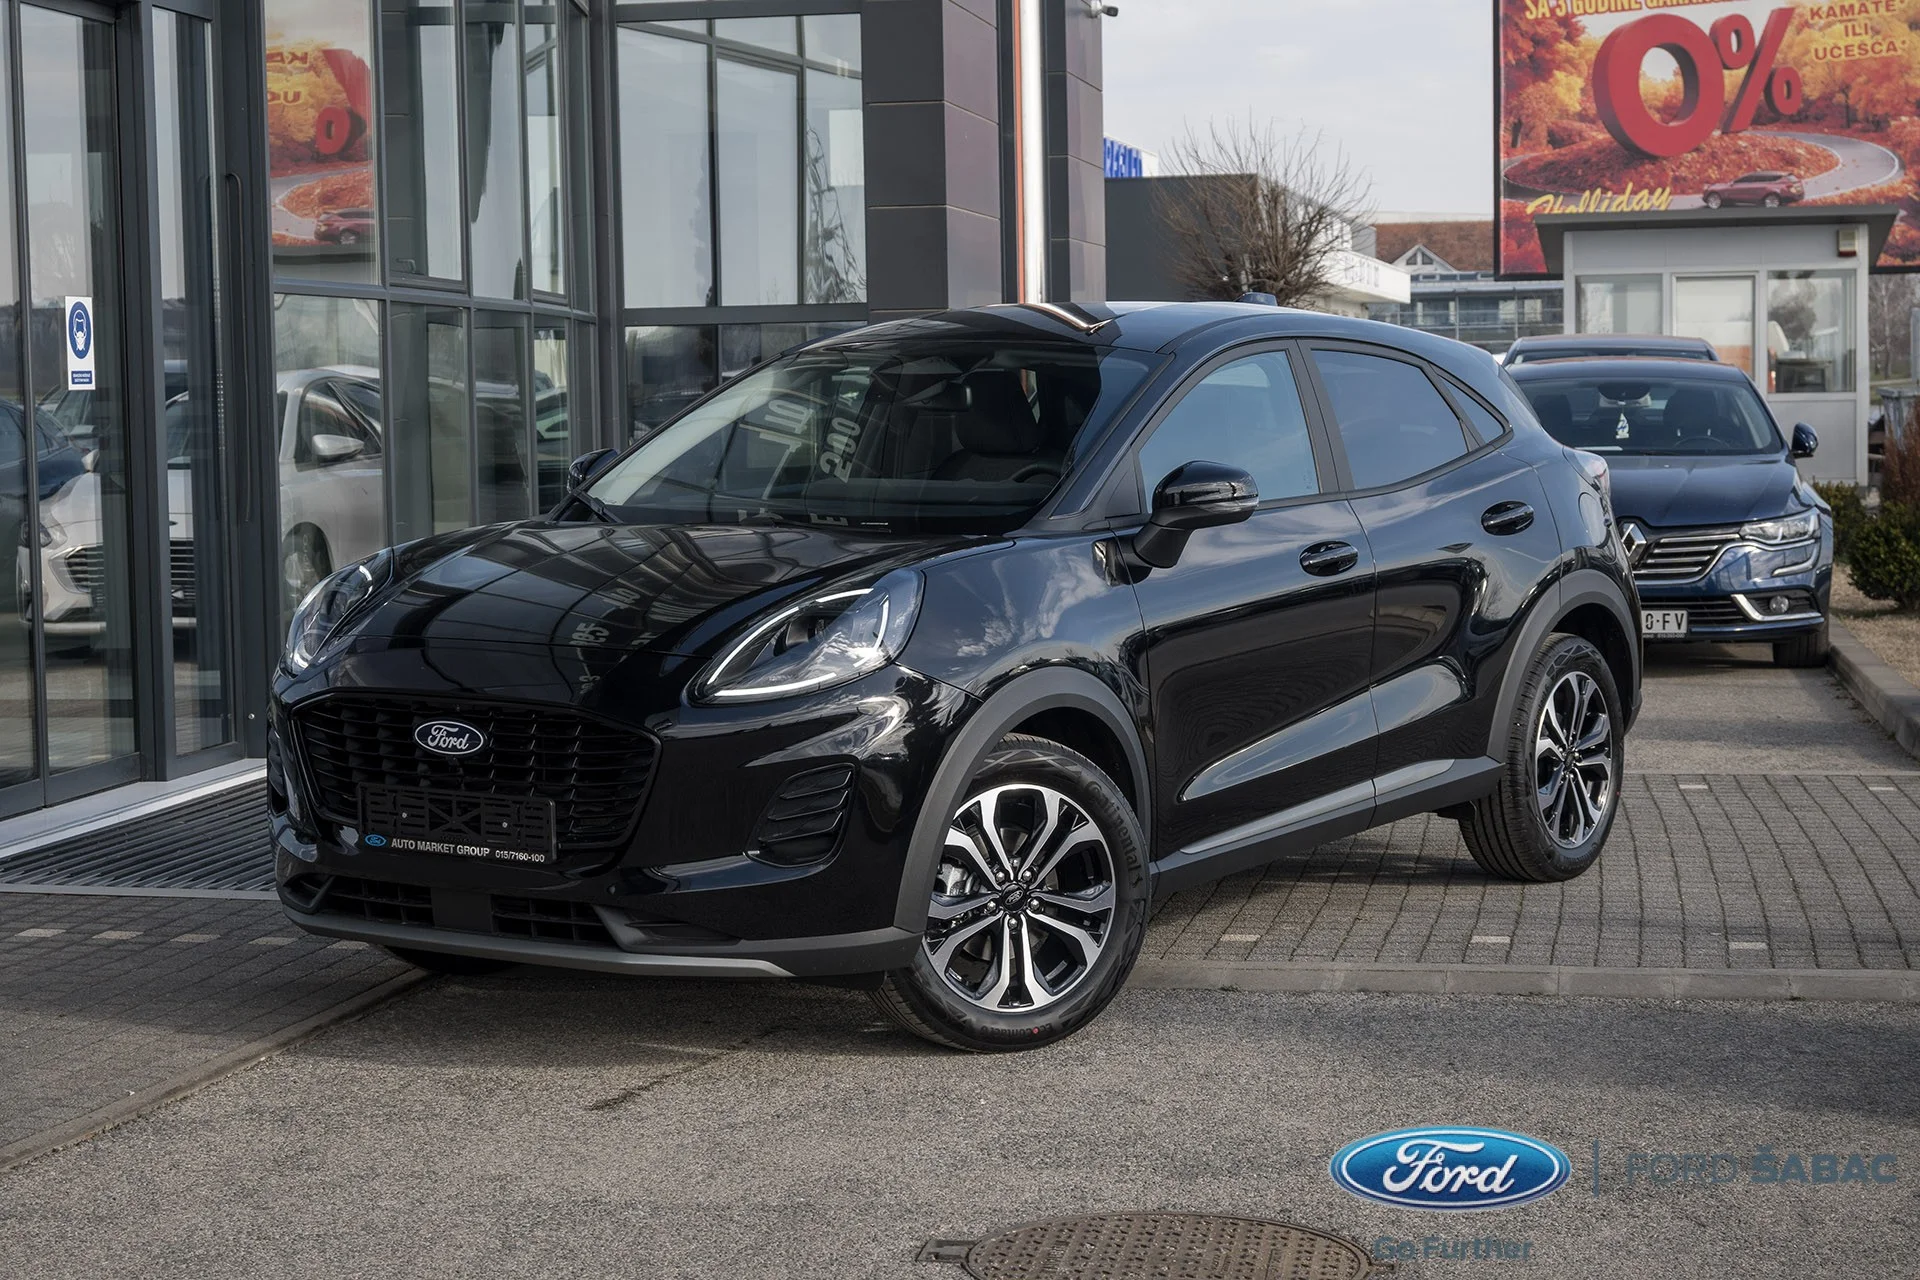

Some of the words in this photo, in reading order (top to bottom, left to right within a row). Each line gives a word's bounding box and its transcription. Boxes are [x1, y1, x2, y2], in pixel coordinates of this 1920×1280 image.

[1809, 0, 1897, 20] KAMATE
[1843, 23, 1869, 37] ILI
[1592, 7, 1801, 159] 0%
[427, 724, 470, 750] Ford
[391, 838, 416, 850] AUTO
[417, 840, 455, 854] MARKET
[456, 844, 490, 857] GROUP
[495, 850, 545, 863] 015/7160-100
